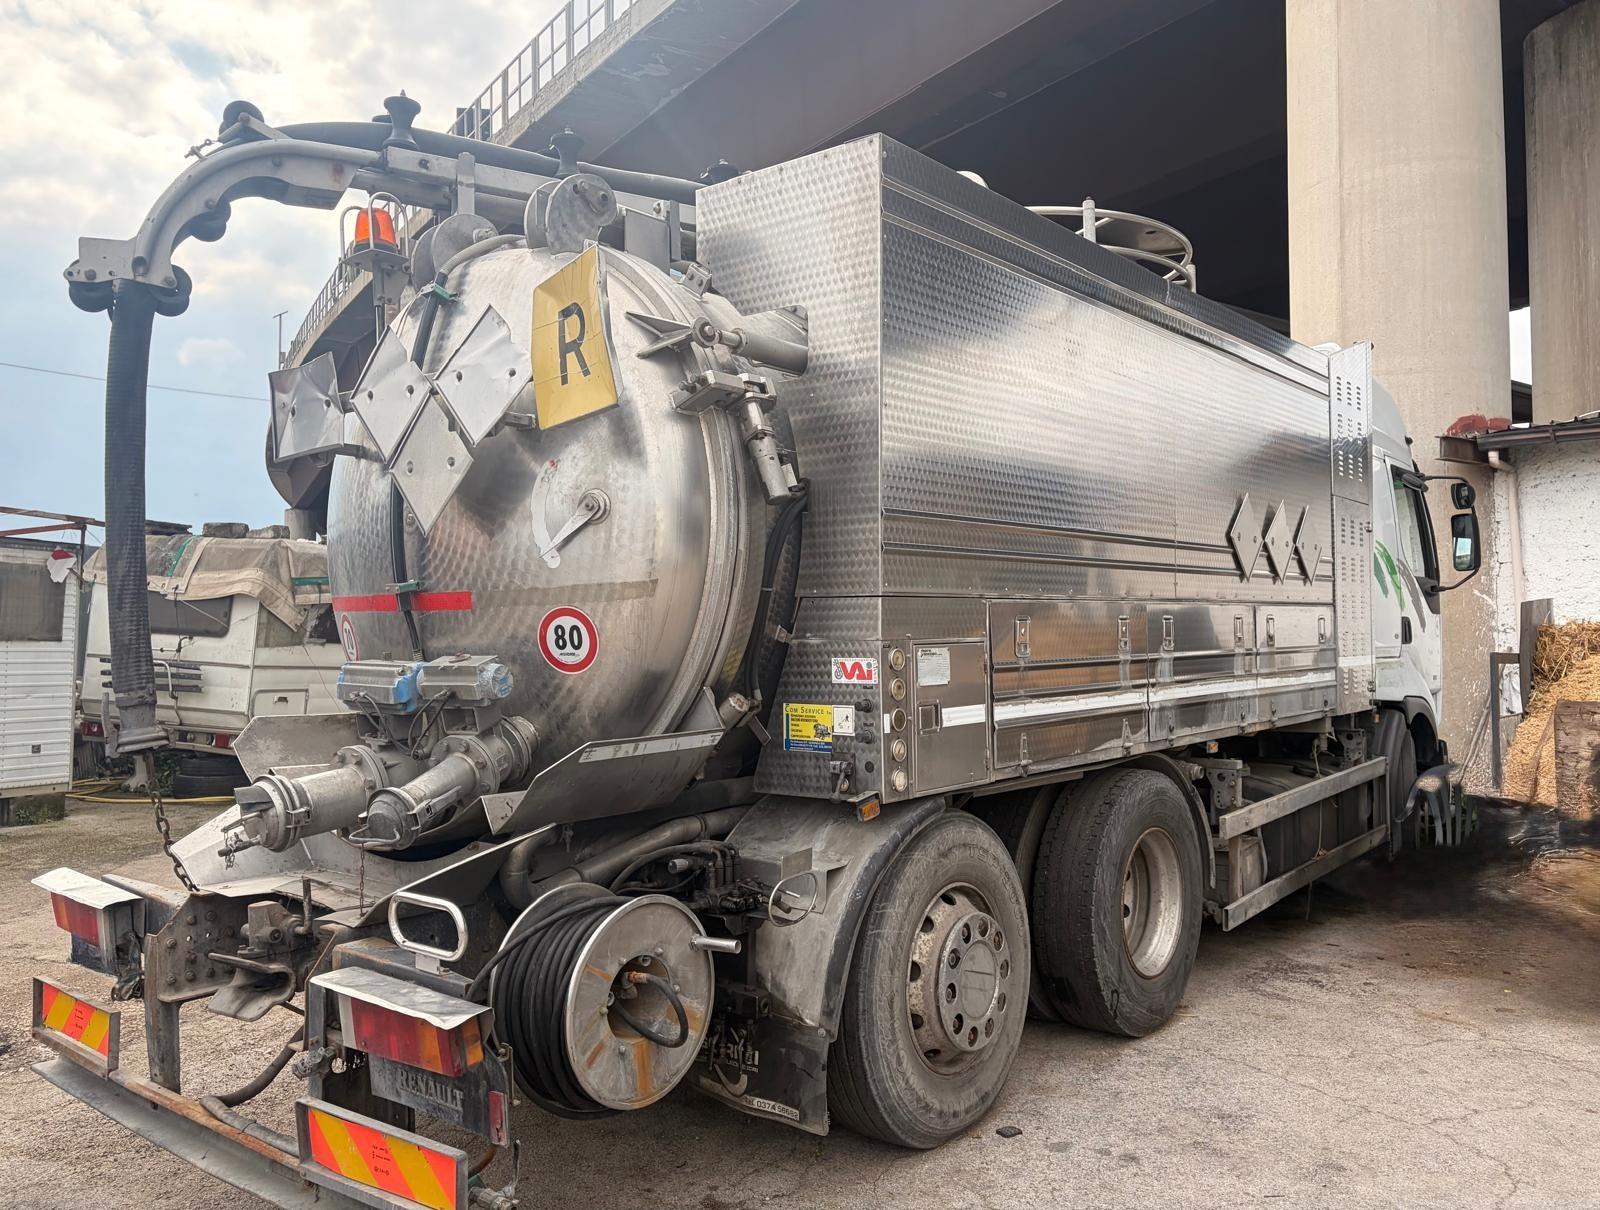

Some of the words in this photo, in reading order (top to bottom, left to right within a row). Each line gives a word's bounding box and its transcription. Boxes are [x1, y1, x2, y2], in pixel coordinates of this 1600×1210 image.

[558, 302, 591, 386] R
[554, 624, 583, 651] 80
[400, 1069, 465, 1109] RENAULT
